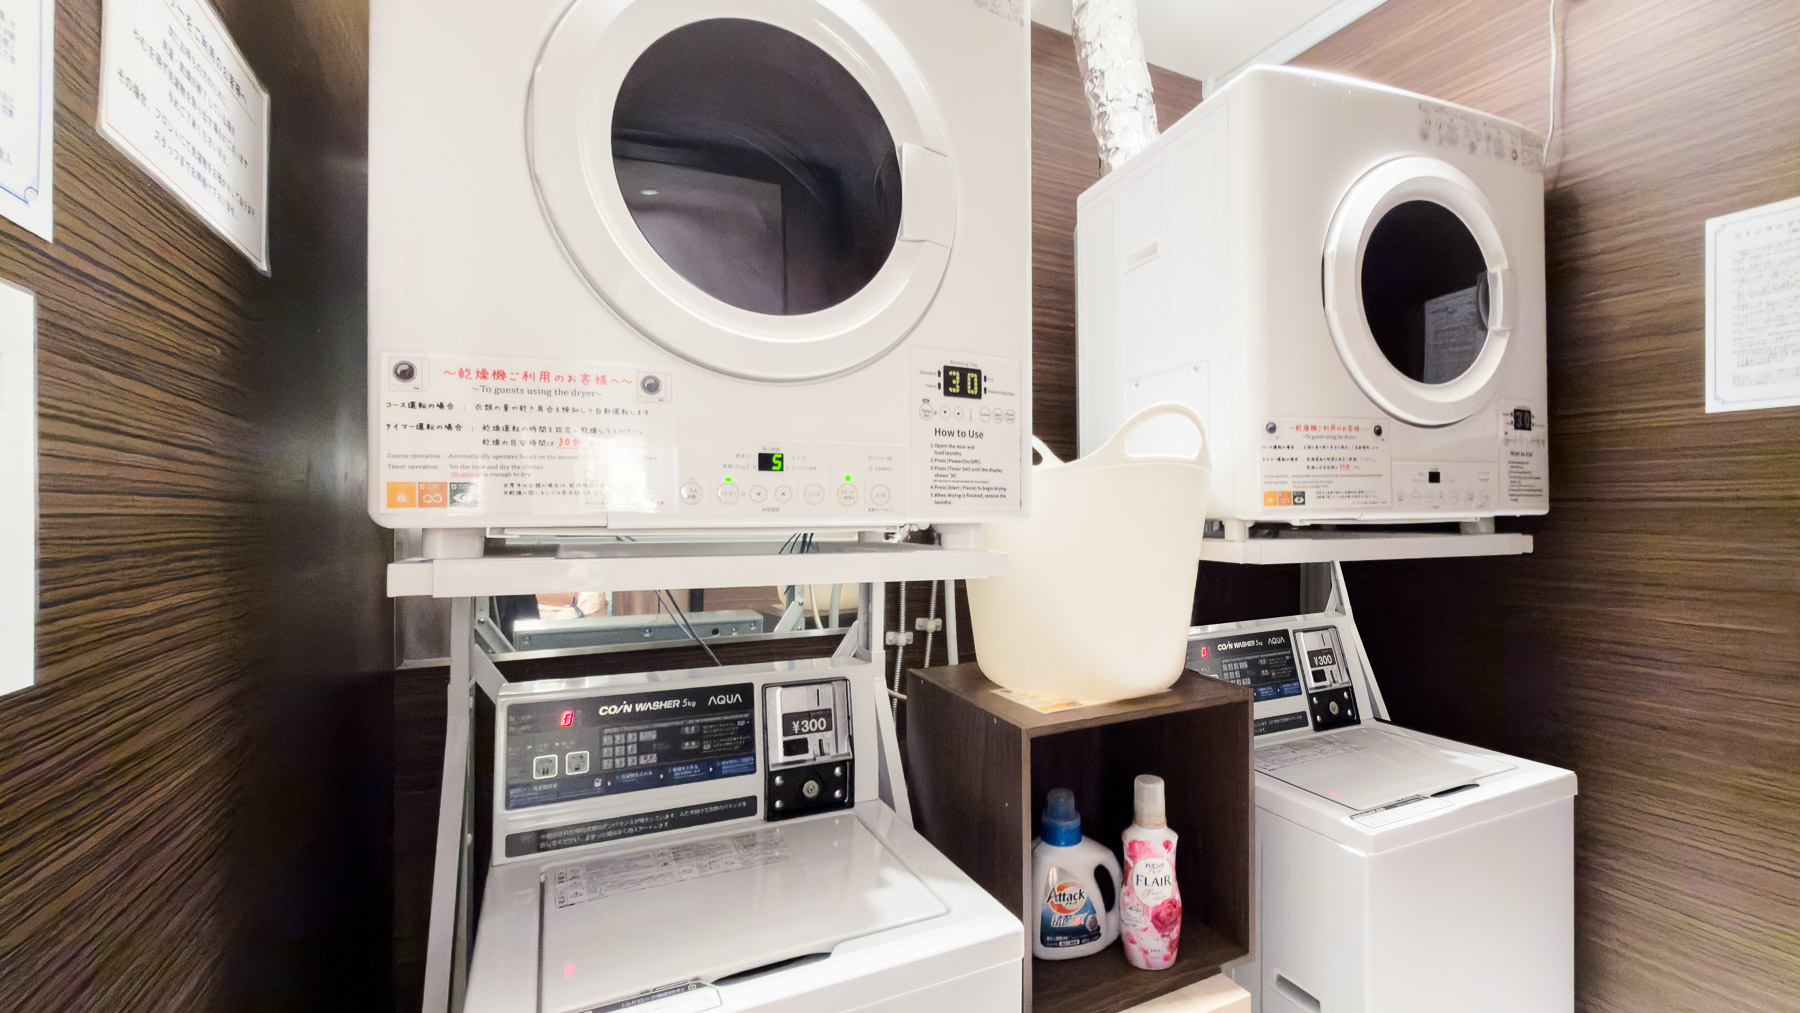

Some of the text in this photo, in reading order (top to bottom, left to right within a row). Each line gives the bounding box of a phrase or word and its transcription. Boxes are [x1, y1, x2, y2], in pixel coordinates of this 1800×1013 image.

[948, 370, 978, 395] 30
[494, 386, 524, 396] guests
[527, 387, 552, 397] using
[554, 388, 569, 397] the
[934, 427, 984, 439] How to Use
[772, 453, 783, 470] 5
[1268, 636, 1285, 645] AQUA
[1313, 654, 1333, 666] ¥300
[636, 699, 680, 712] WASHER
[708, 694, 742, 706] AQUA
[792, 718, 827, 734] ¥300
[1136, 874, 1172, 887] FLAIR
[1046, 887, 1085, 903] Attack
